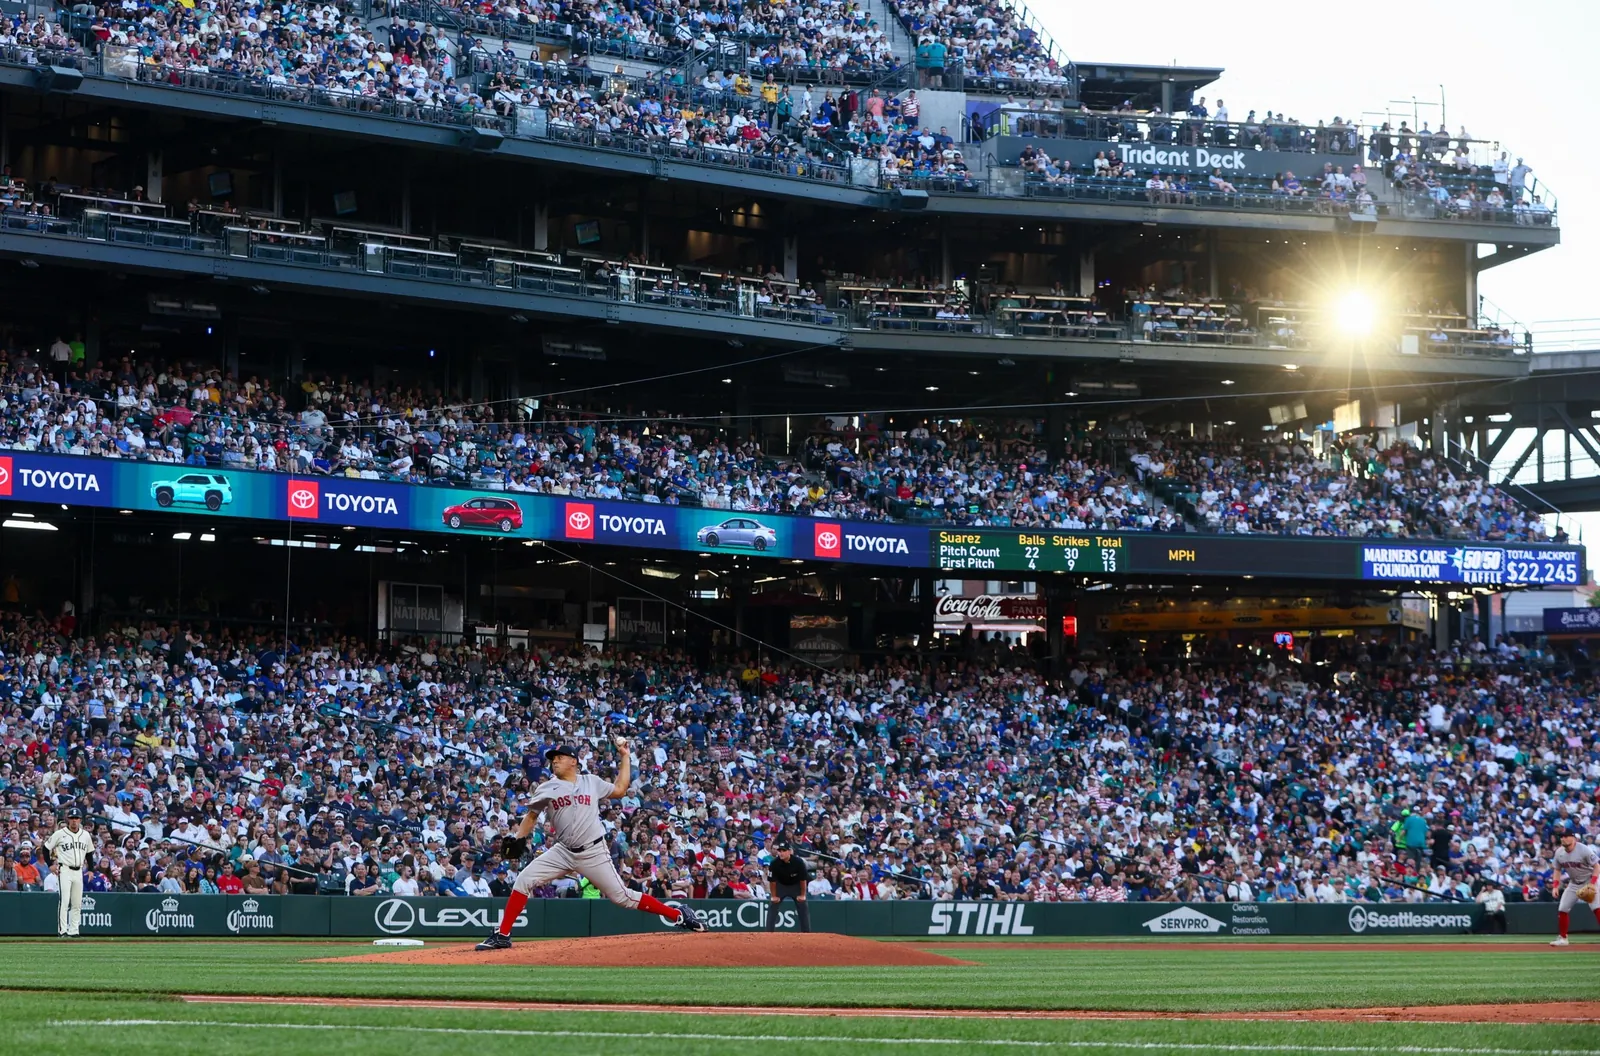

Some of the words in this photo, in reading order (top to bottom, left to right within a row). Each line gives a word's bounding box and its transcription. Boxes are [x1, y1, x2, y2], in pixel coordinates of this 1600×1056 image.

[1118, 144, 1189, 166] Trident
[1196, 149, 1246, 170] Deck
[19, 468, 99, 492] TOYOTA
[325, 492, 398, 515] TOYOTA
[599, 514, 666, 535] TOYOTA
[845, 534, 909, 554] TOYOTA
[939, 532, 981, 544] Suarez
[1018, 534, 1046, 546] Balls
[1052, 536, 1090, 547] Strikes
[1096, 537, 1122, 548] Total
[940, 546, 968, 557] Pitch
[971, 547, 1000, 558] Count
[1025, 547, 1040, 559] 22
[1064, 548, 1079, 560] 30
[1101, 549, 1116, 560] 52
[1168, 550, 1195, 561] MPH
[1364, 548, 1418, 563] MARINERS
[1420, 550, 1448, 564] CARE
[1507, 550, 1536, 560] TOTAL
[1537, 551, 1577, 561] JACKPOT
[940, 558, 964, 569] First
[967, 558, 995, 570] Pitch
[1028, 559, 1036, 570] 4
[1067, 560, 1075, 571] 9
[1103, 561, 1116, 572] 13
[1373, 563, 1440, 578] FOUNDATION
[1507, 561, 1577, 583] $22,245
[1463, 572, 1502, 584] RAFFLE
[935, 595, 1002, 617] Coca-Cola
[1012, 606, 1033, 615] FAN
[394, 606, 440, 620] NATURAL
[551, 795, 591, 810] BOSTON
[61, 841, 87, 852] SEATTL
[145, 907, 195, 933] Corona
[659, 901, 733, 928] Geat
[927, 902, 1035, 935] STIHL
[226, 909, 274, 934] Corona
[1160, 918, 1209, 929] SERVPRO
